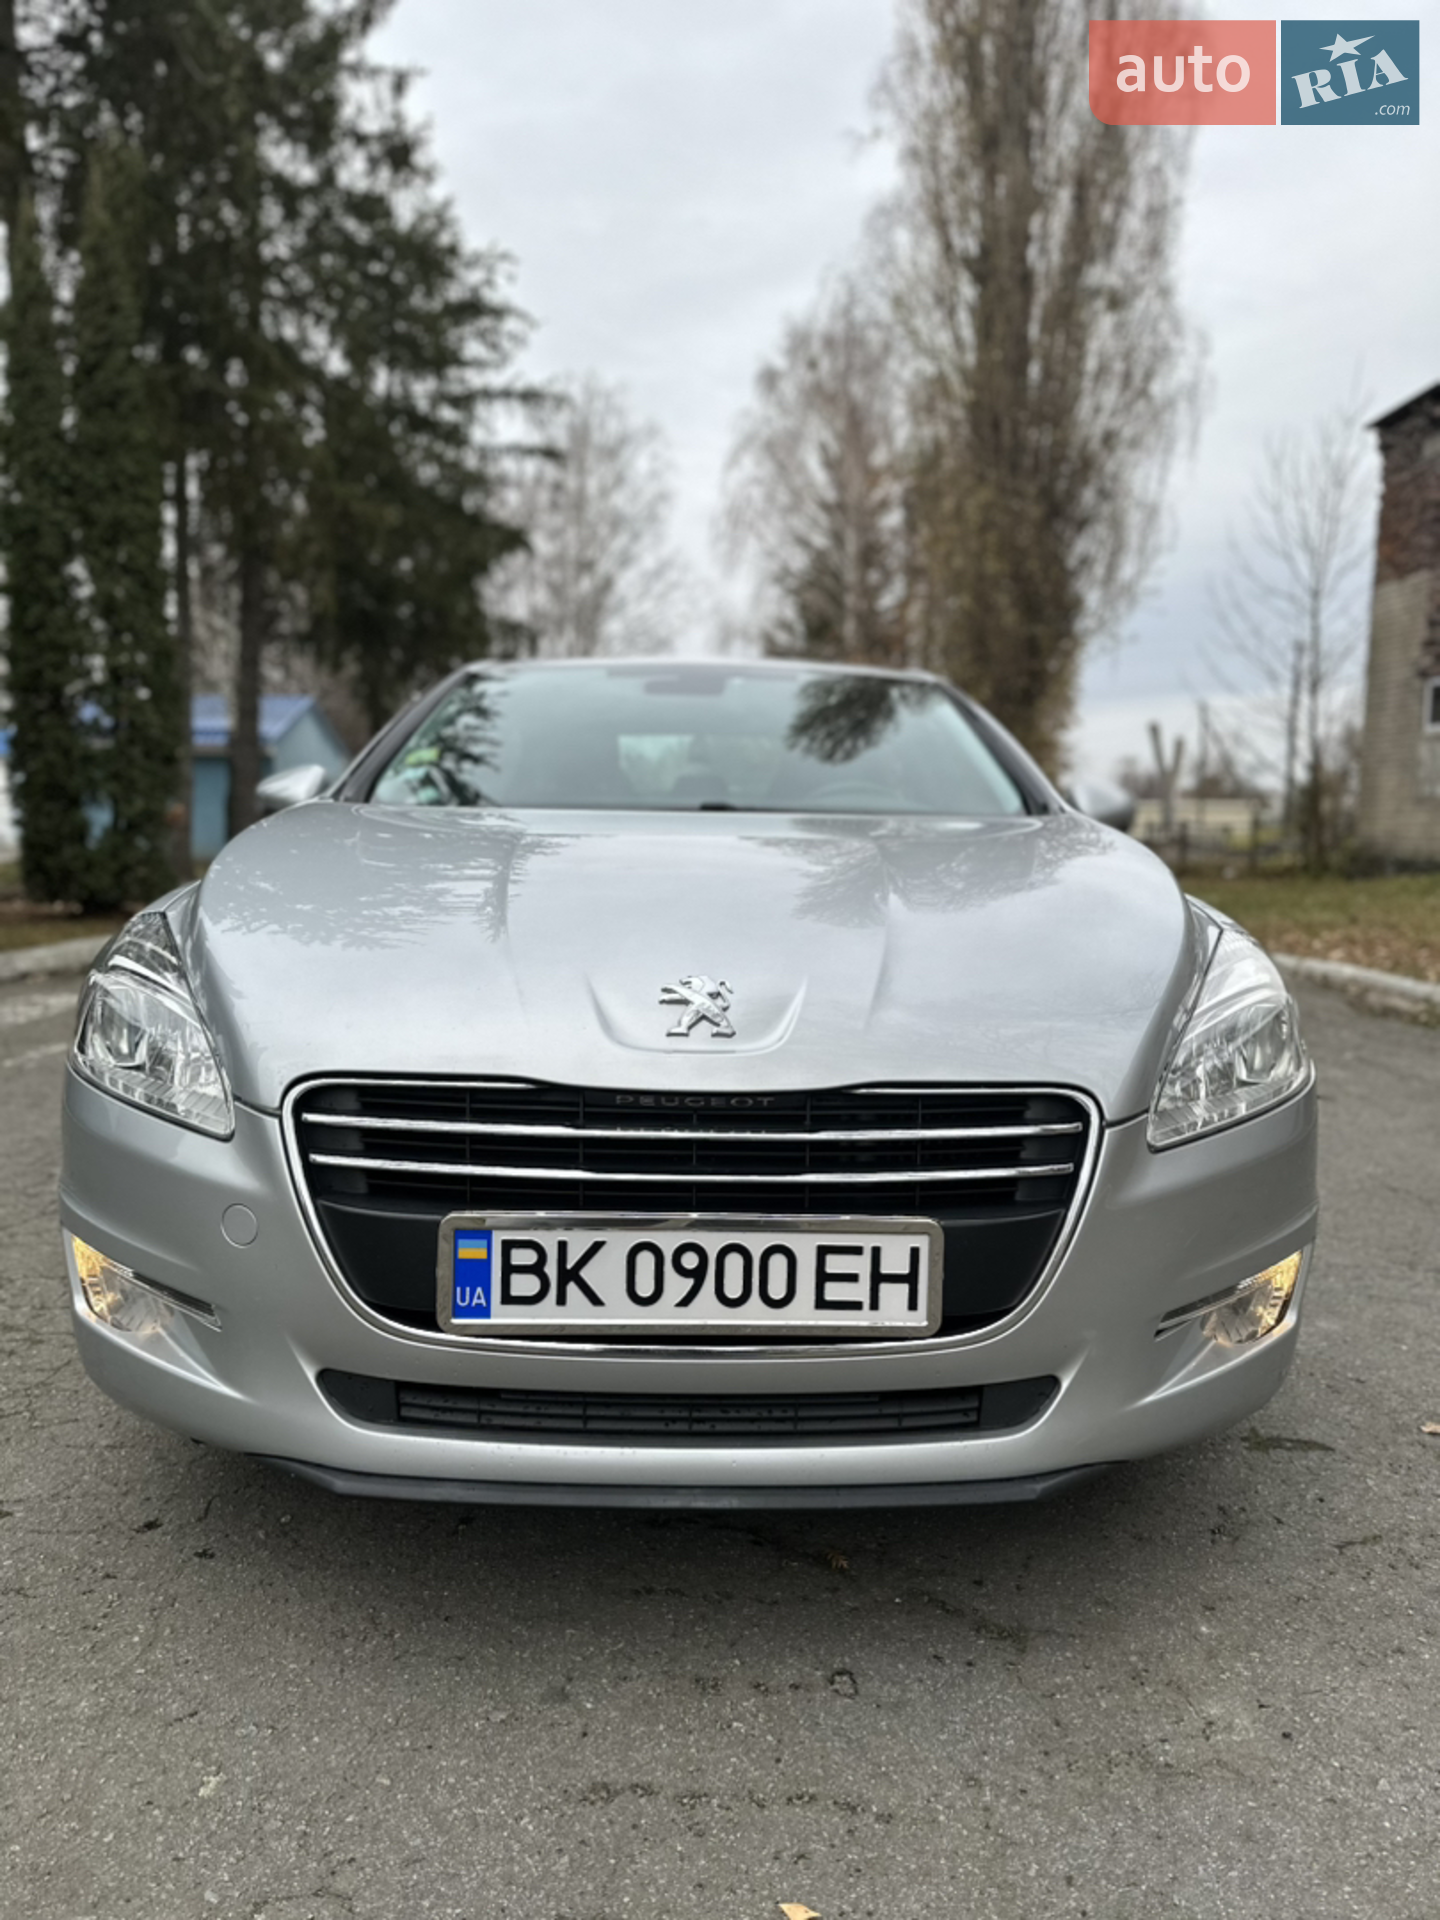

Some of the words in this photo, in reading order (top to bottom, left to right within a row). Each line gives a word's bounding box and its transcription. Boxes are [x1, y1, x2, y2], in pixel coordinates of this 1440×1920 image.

[615, 1094, 776, 1108] PEUGEOT
[499, 1238, 608, 1306] BK
[625, 1241, 798, 1310] 0900
[814, 1244, 920, 1312] EH
[456, 1286, 488, 1308] UA
